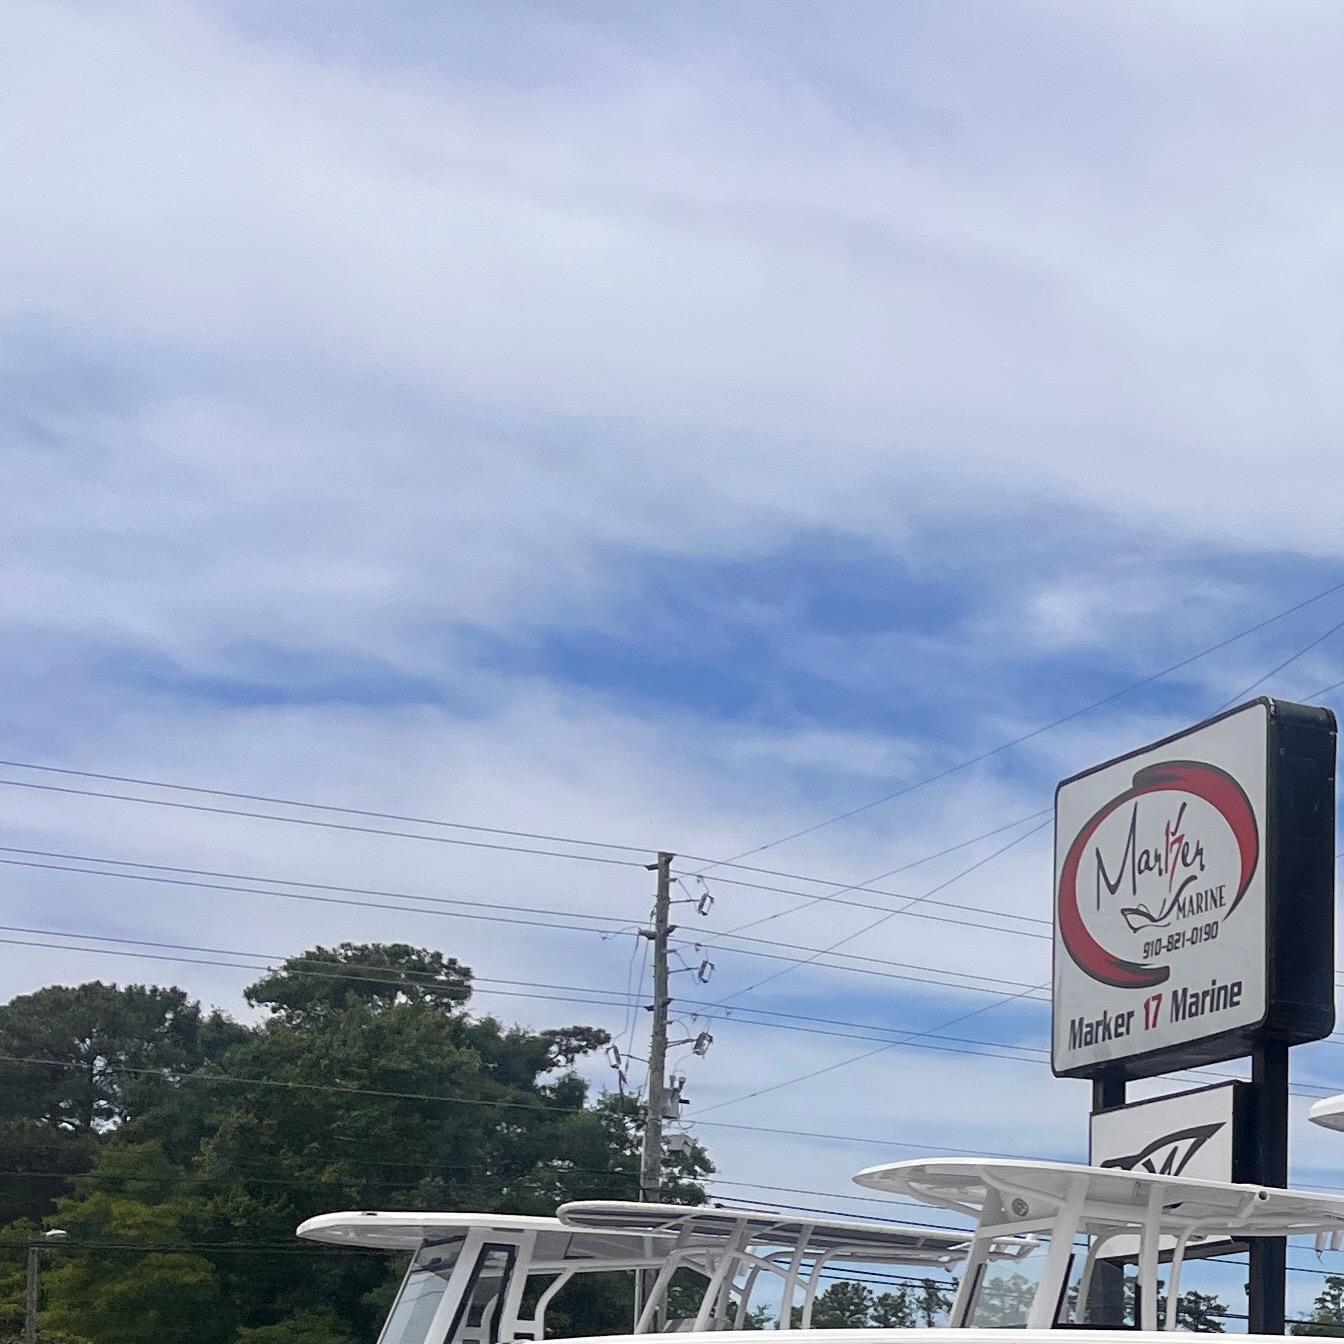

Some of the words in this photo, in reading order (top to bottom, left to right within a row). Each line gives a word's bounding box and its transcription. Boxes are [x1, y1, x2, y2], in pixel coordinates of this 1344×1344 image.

[1176, 884, 1226, 920] MARINE
[1143, 921, 1219, 959] 910-821-0190
[1068, 1010, 1135, 1051] Marker
[1144, 992, 1163, 1031] 17
[1170, 979, 1242, 1024] Marine
